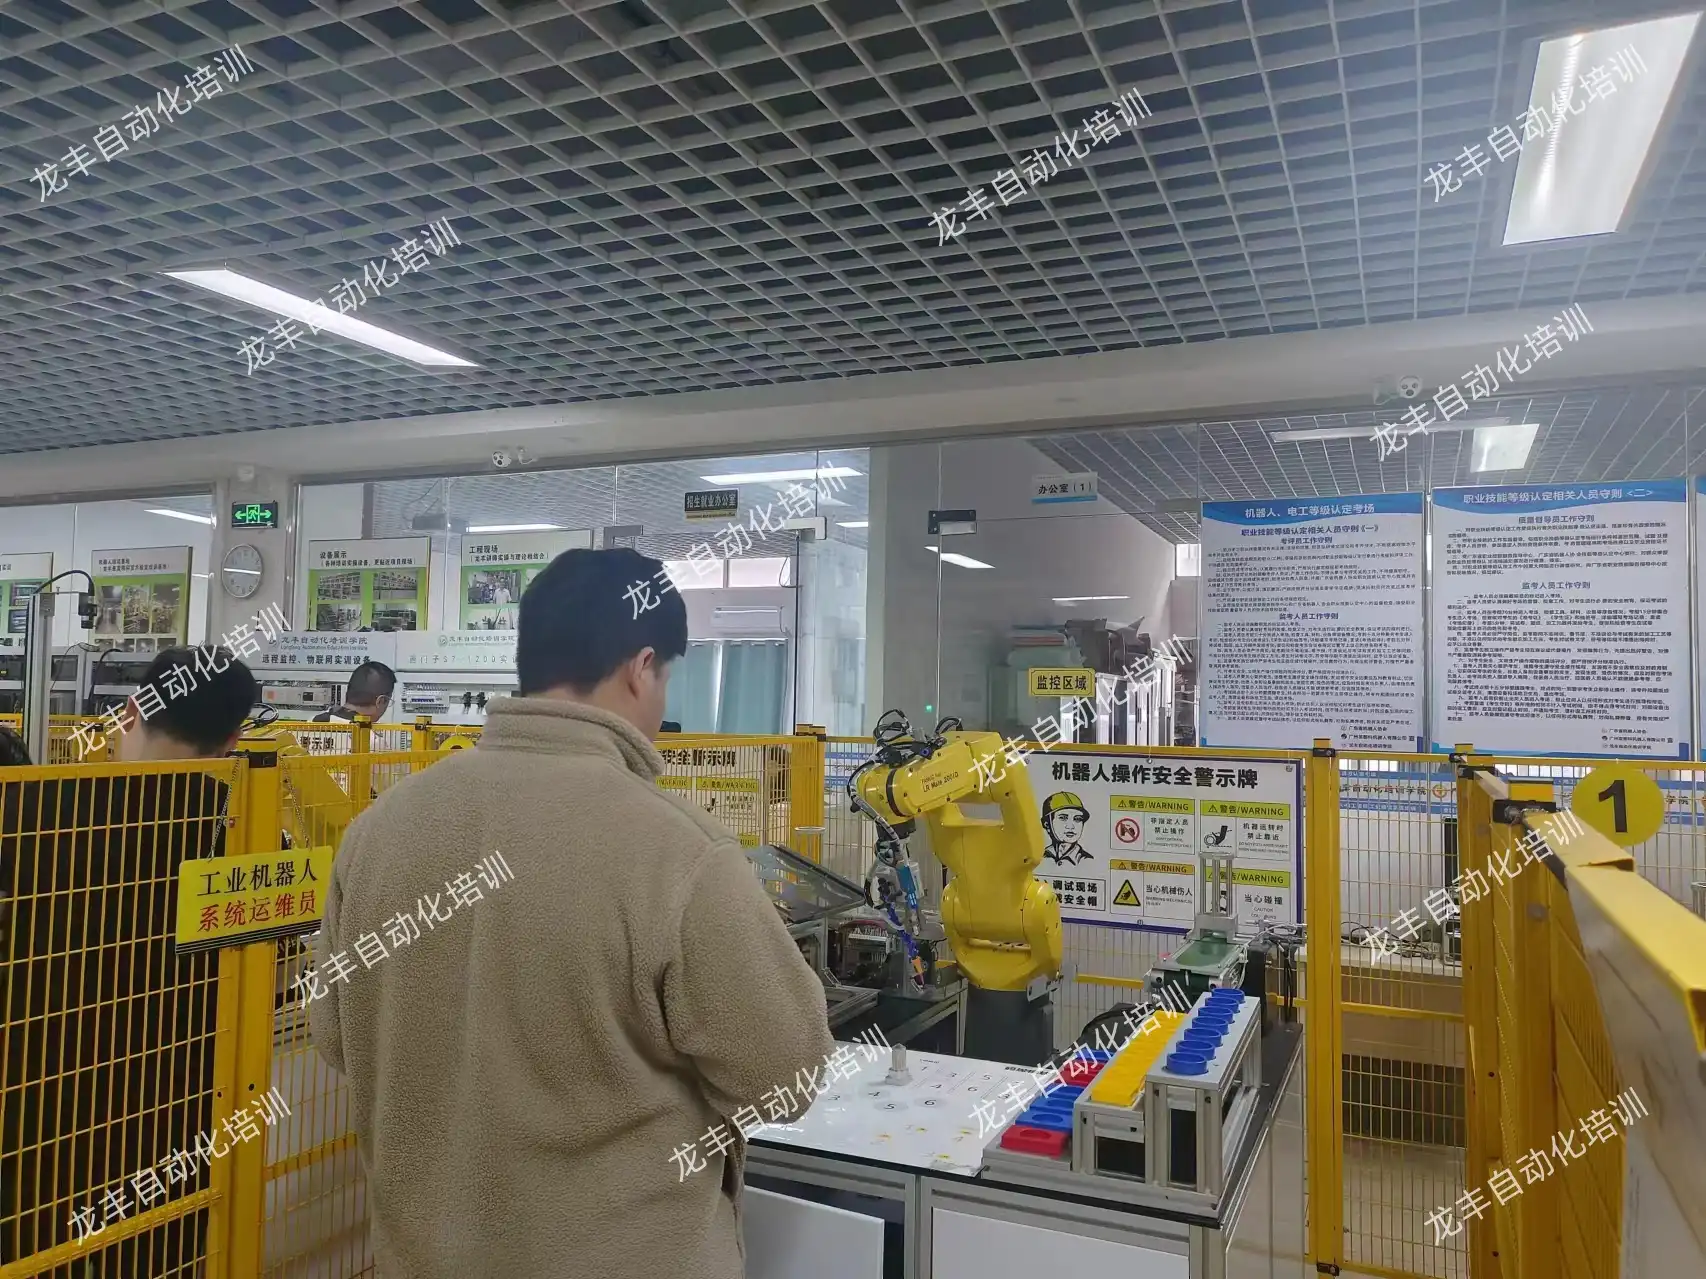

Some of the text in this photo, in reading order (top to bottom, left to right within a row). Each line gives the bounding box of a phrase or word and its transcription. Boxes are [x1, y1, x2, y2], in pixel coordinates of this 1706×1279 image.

[1245, 504, 1375, 518] 机器人、电工等级认定考场
[319, 550, 347, 559] 设备展示
[469, 544, 498, 554] 工程现场
[1037, 675, 1087, 690] 监控区域
[1052, 761, 1258, 789] 机器人操作安全警示牌
[1338, 783, 1427, 796] 丰自动化培训学院
[1129, 800, 1189, 811] 警告/WARNING
[1220, 805, 1284, 816] 警告/WARNING
[1598, 779, 1628, 833] 1
[1130, 863, 1187, 873] 警告/WARNING
[197, 858, 318, 896] 工业机器人
[1146, 884, 1193, 896] 当心机械伤人
[1244, 894, 1283, 905] 当心碰撞
[197, 889, 316, 932] 系统运维员
